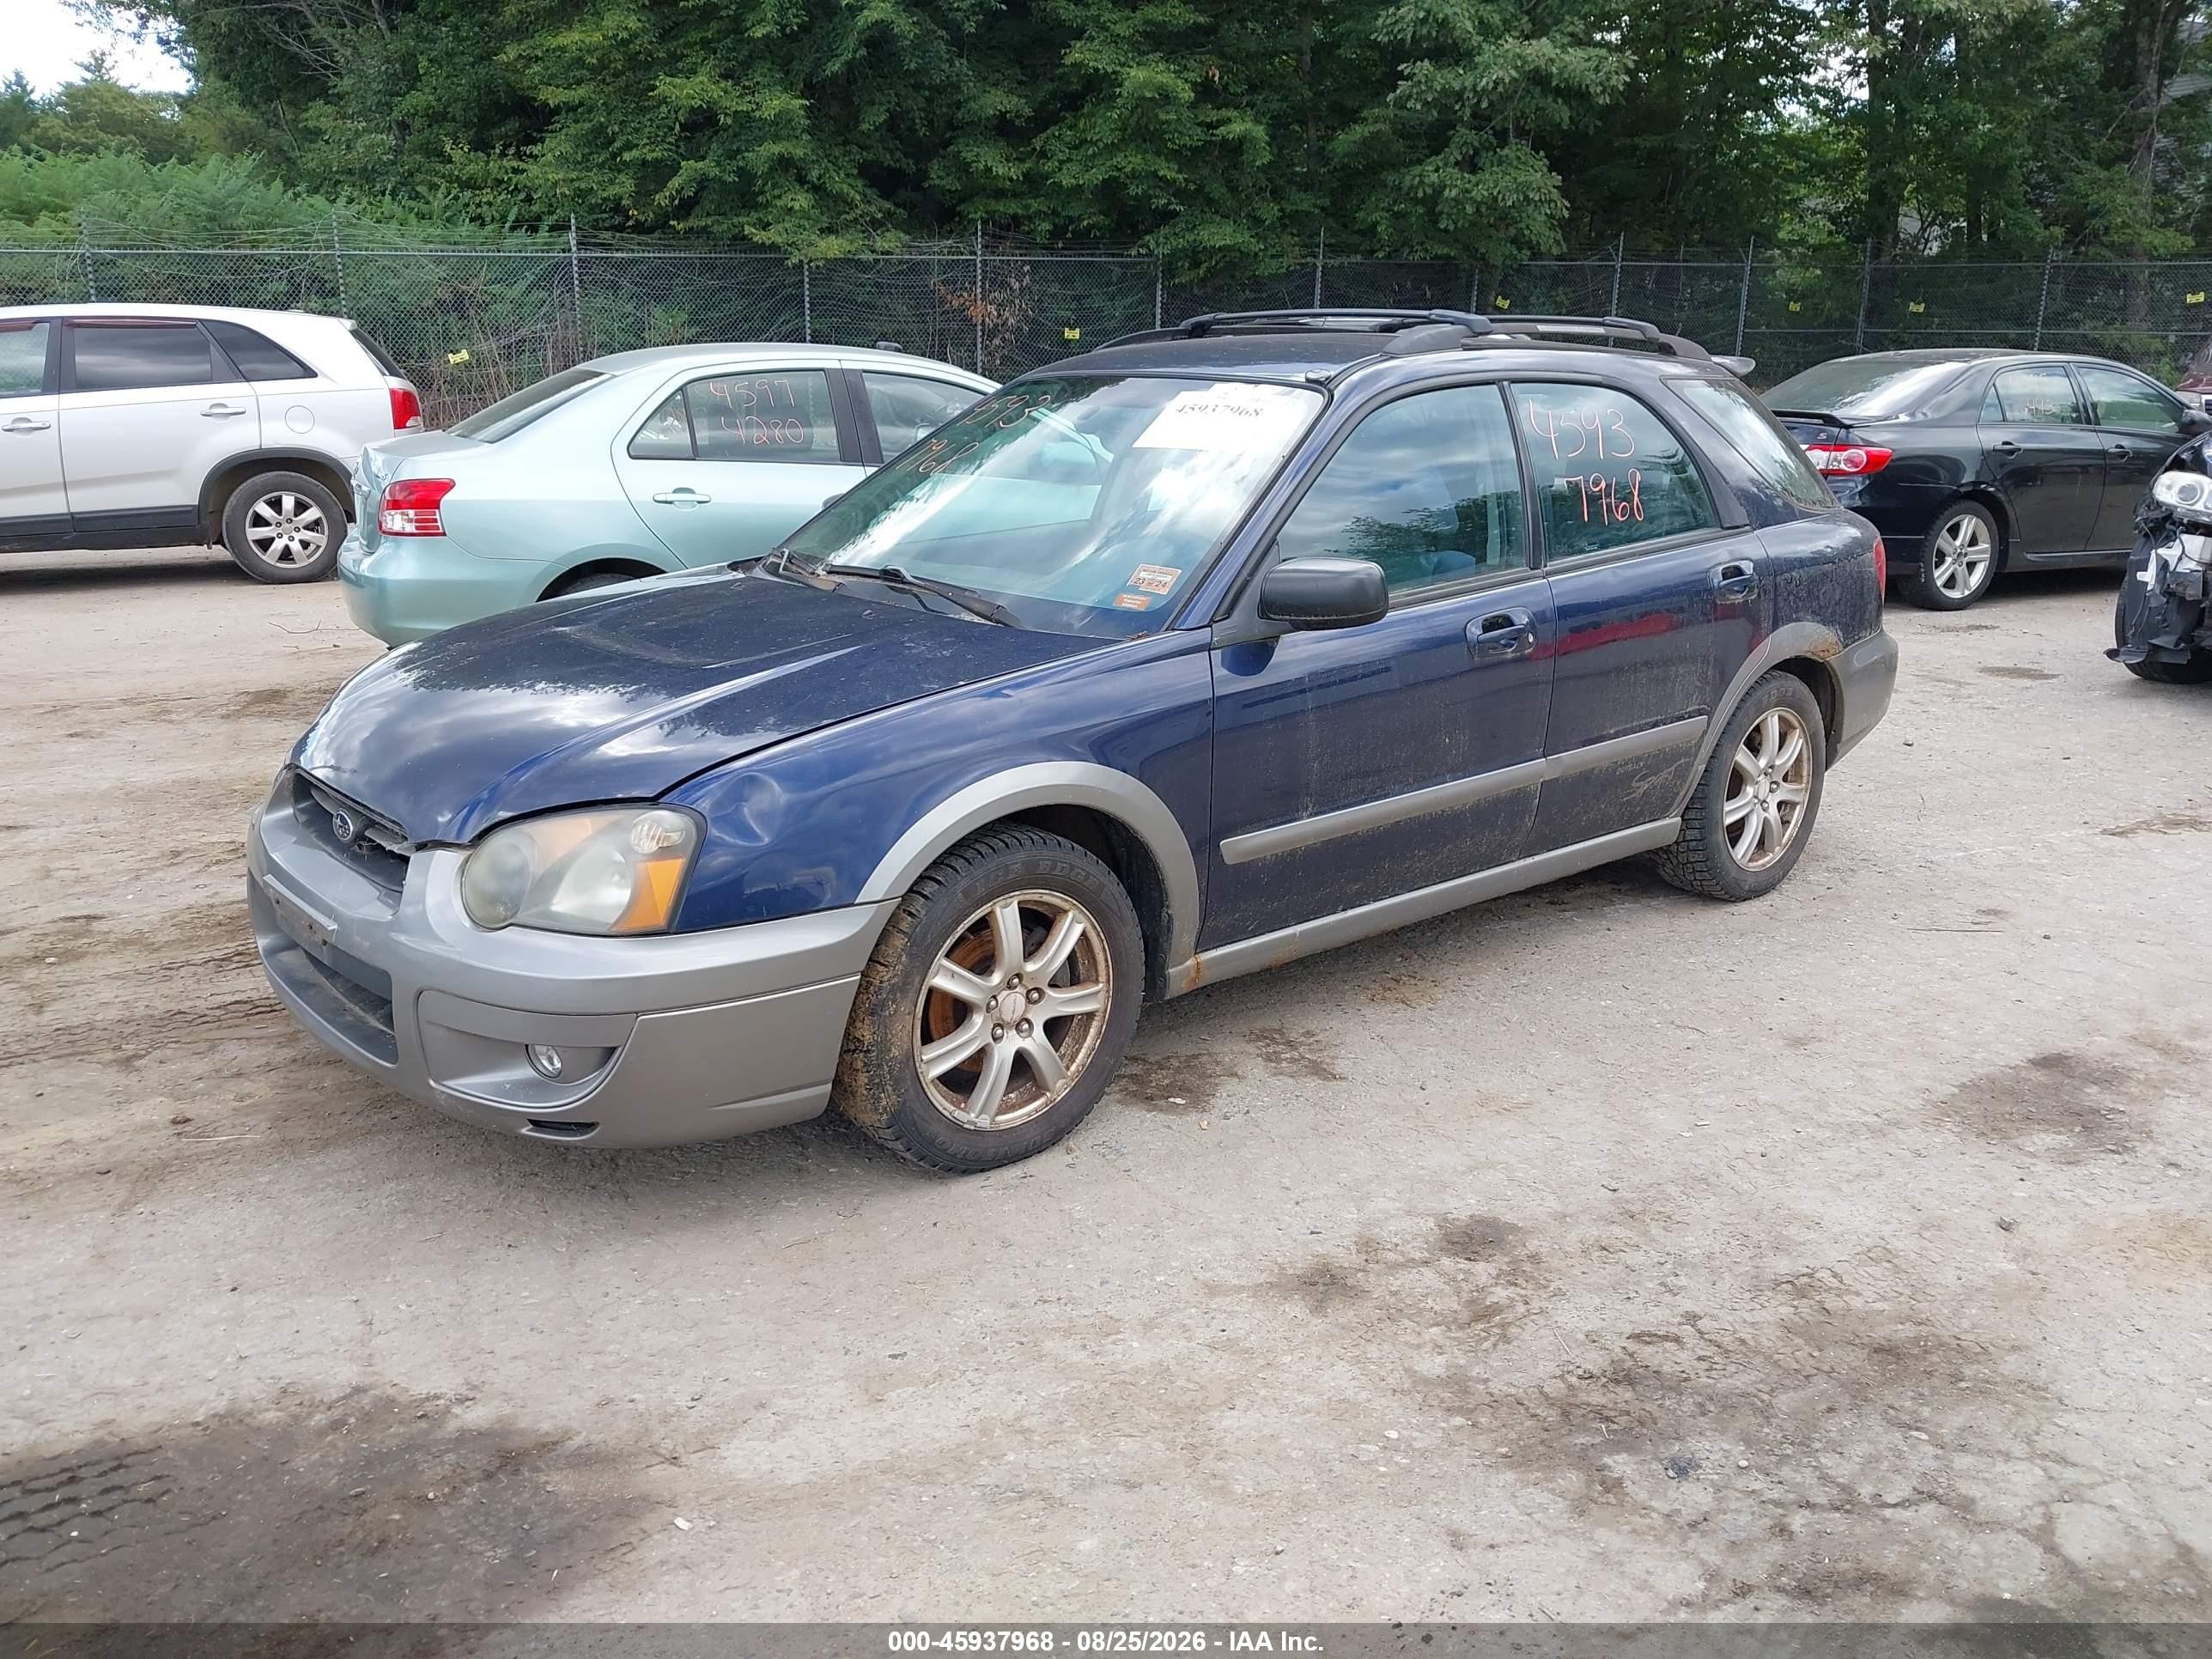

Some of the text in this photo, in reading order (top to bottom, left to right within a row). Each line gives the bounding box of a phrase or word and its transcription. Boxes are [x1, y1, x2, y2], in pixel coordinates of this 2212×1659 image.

[709, 379, 794, 409] 4597
[721, 416, 804, 445] 4280
[1528, 398, 1635, 460] 4593
[1564, 468, 1644, 526] 7968
